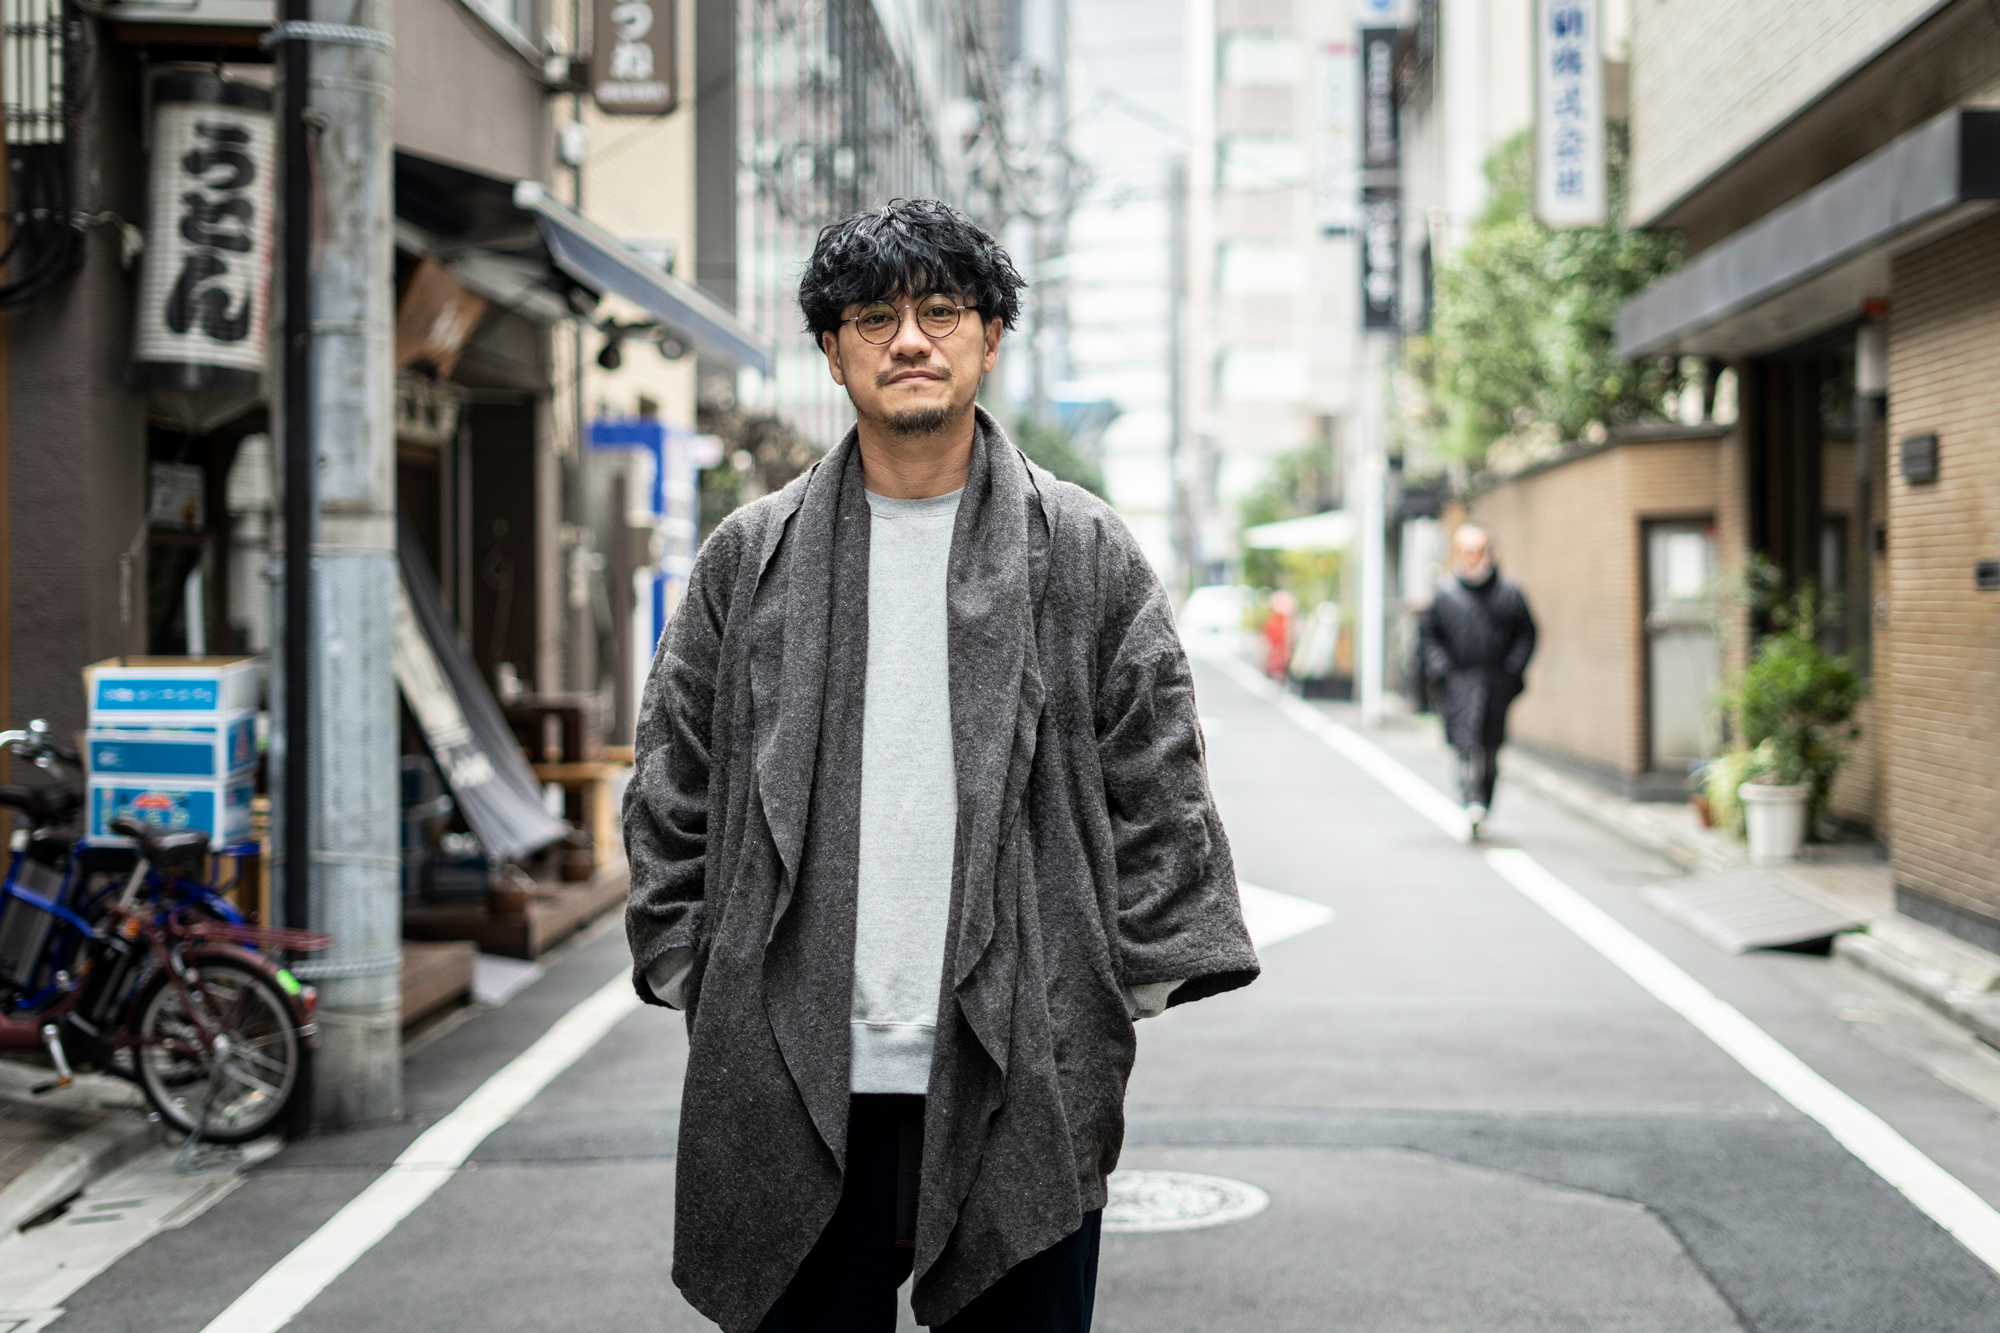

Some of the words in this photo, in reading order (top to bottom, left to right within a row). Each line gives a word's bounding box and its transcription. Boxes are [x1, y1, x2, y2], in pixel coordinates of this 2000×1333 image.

[609, 0, 654, 79] つね
[167, 121, 256, 342] うどん
